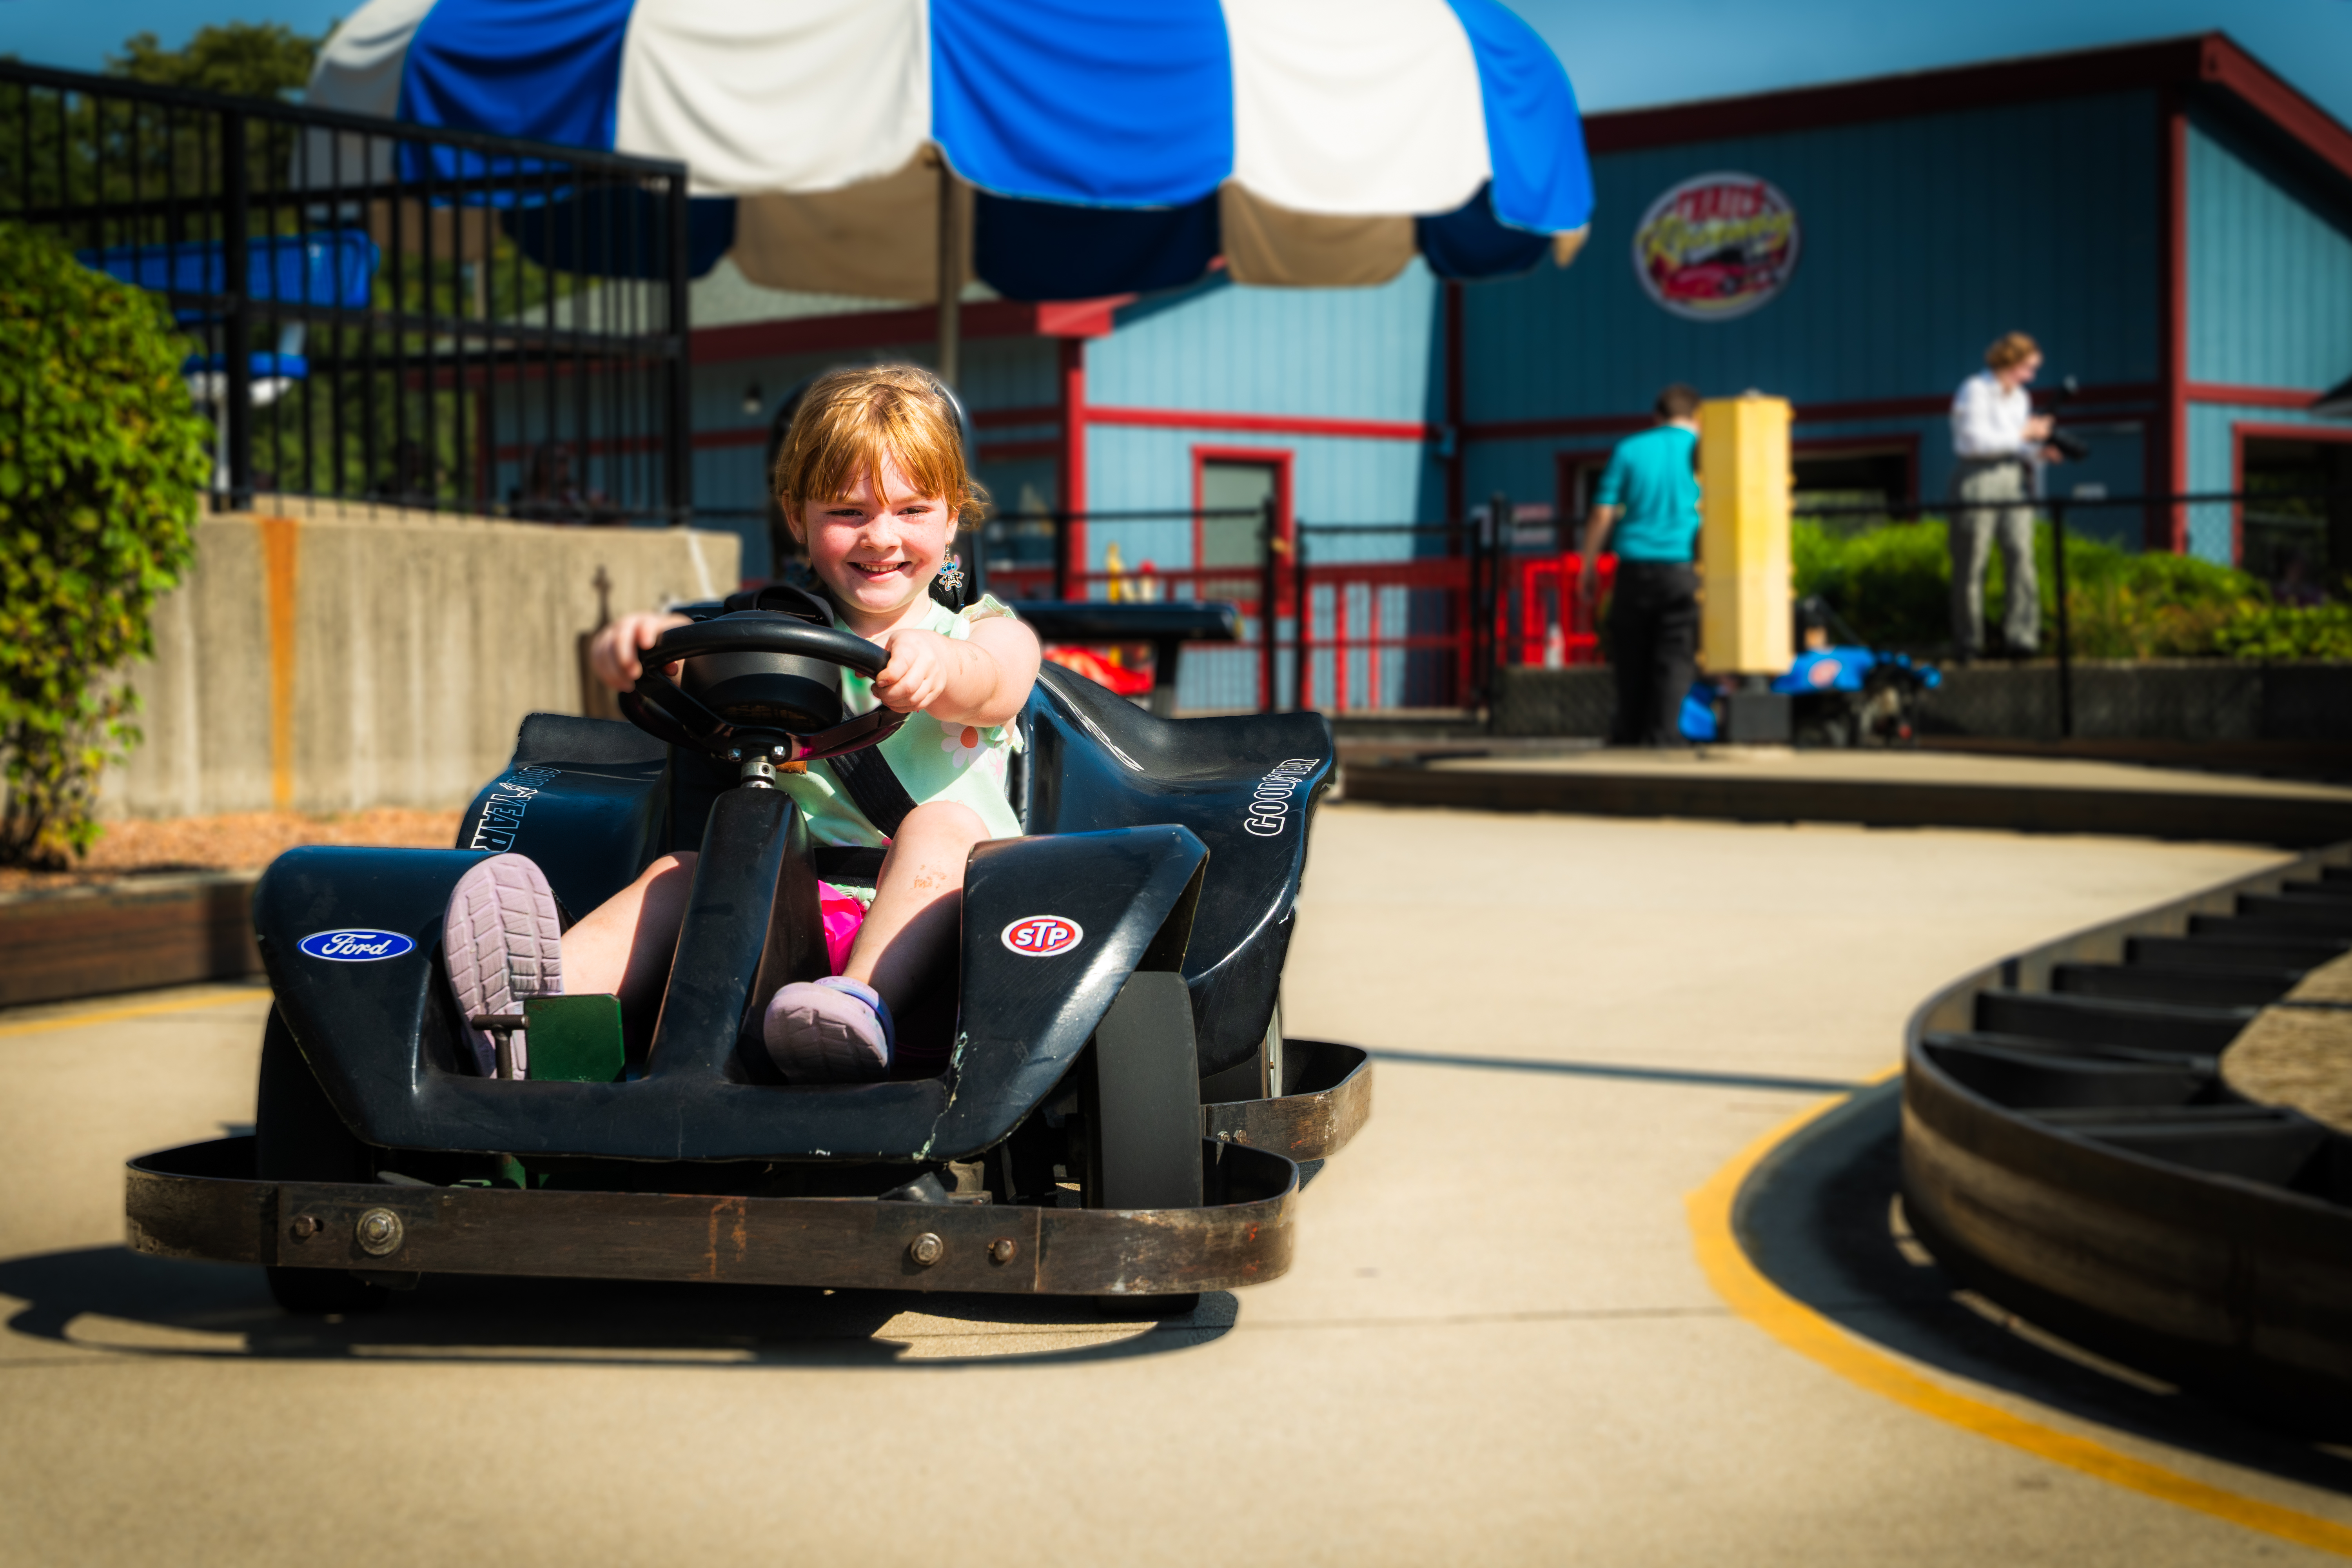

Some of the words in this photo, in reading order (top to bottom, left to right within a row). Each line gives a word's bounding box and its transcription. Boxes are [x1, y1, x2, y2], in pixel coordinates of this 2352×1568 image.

[470, 766, 561, 853] GOODYEAR
[1244, 759, 1320, 836] GOODYEAR
[321, 933, 393, 955] Ford
[1015, 922, 1069, 948] STP
